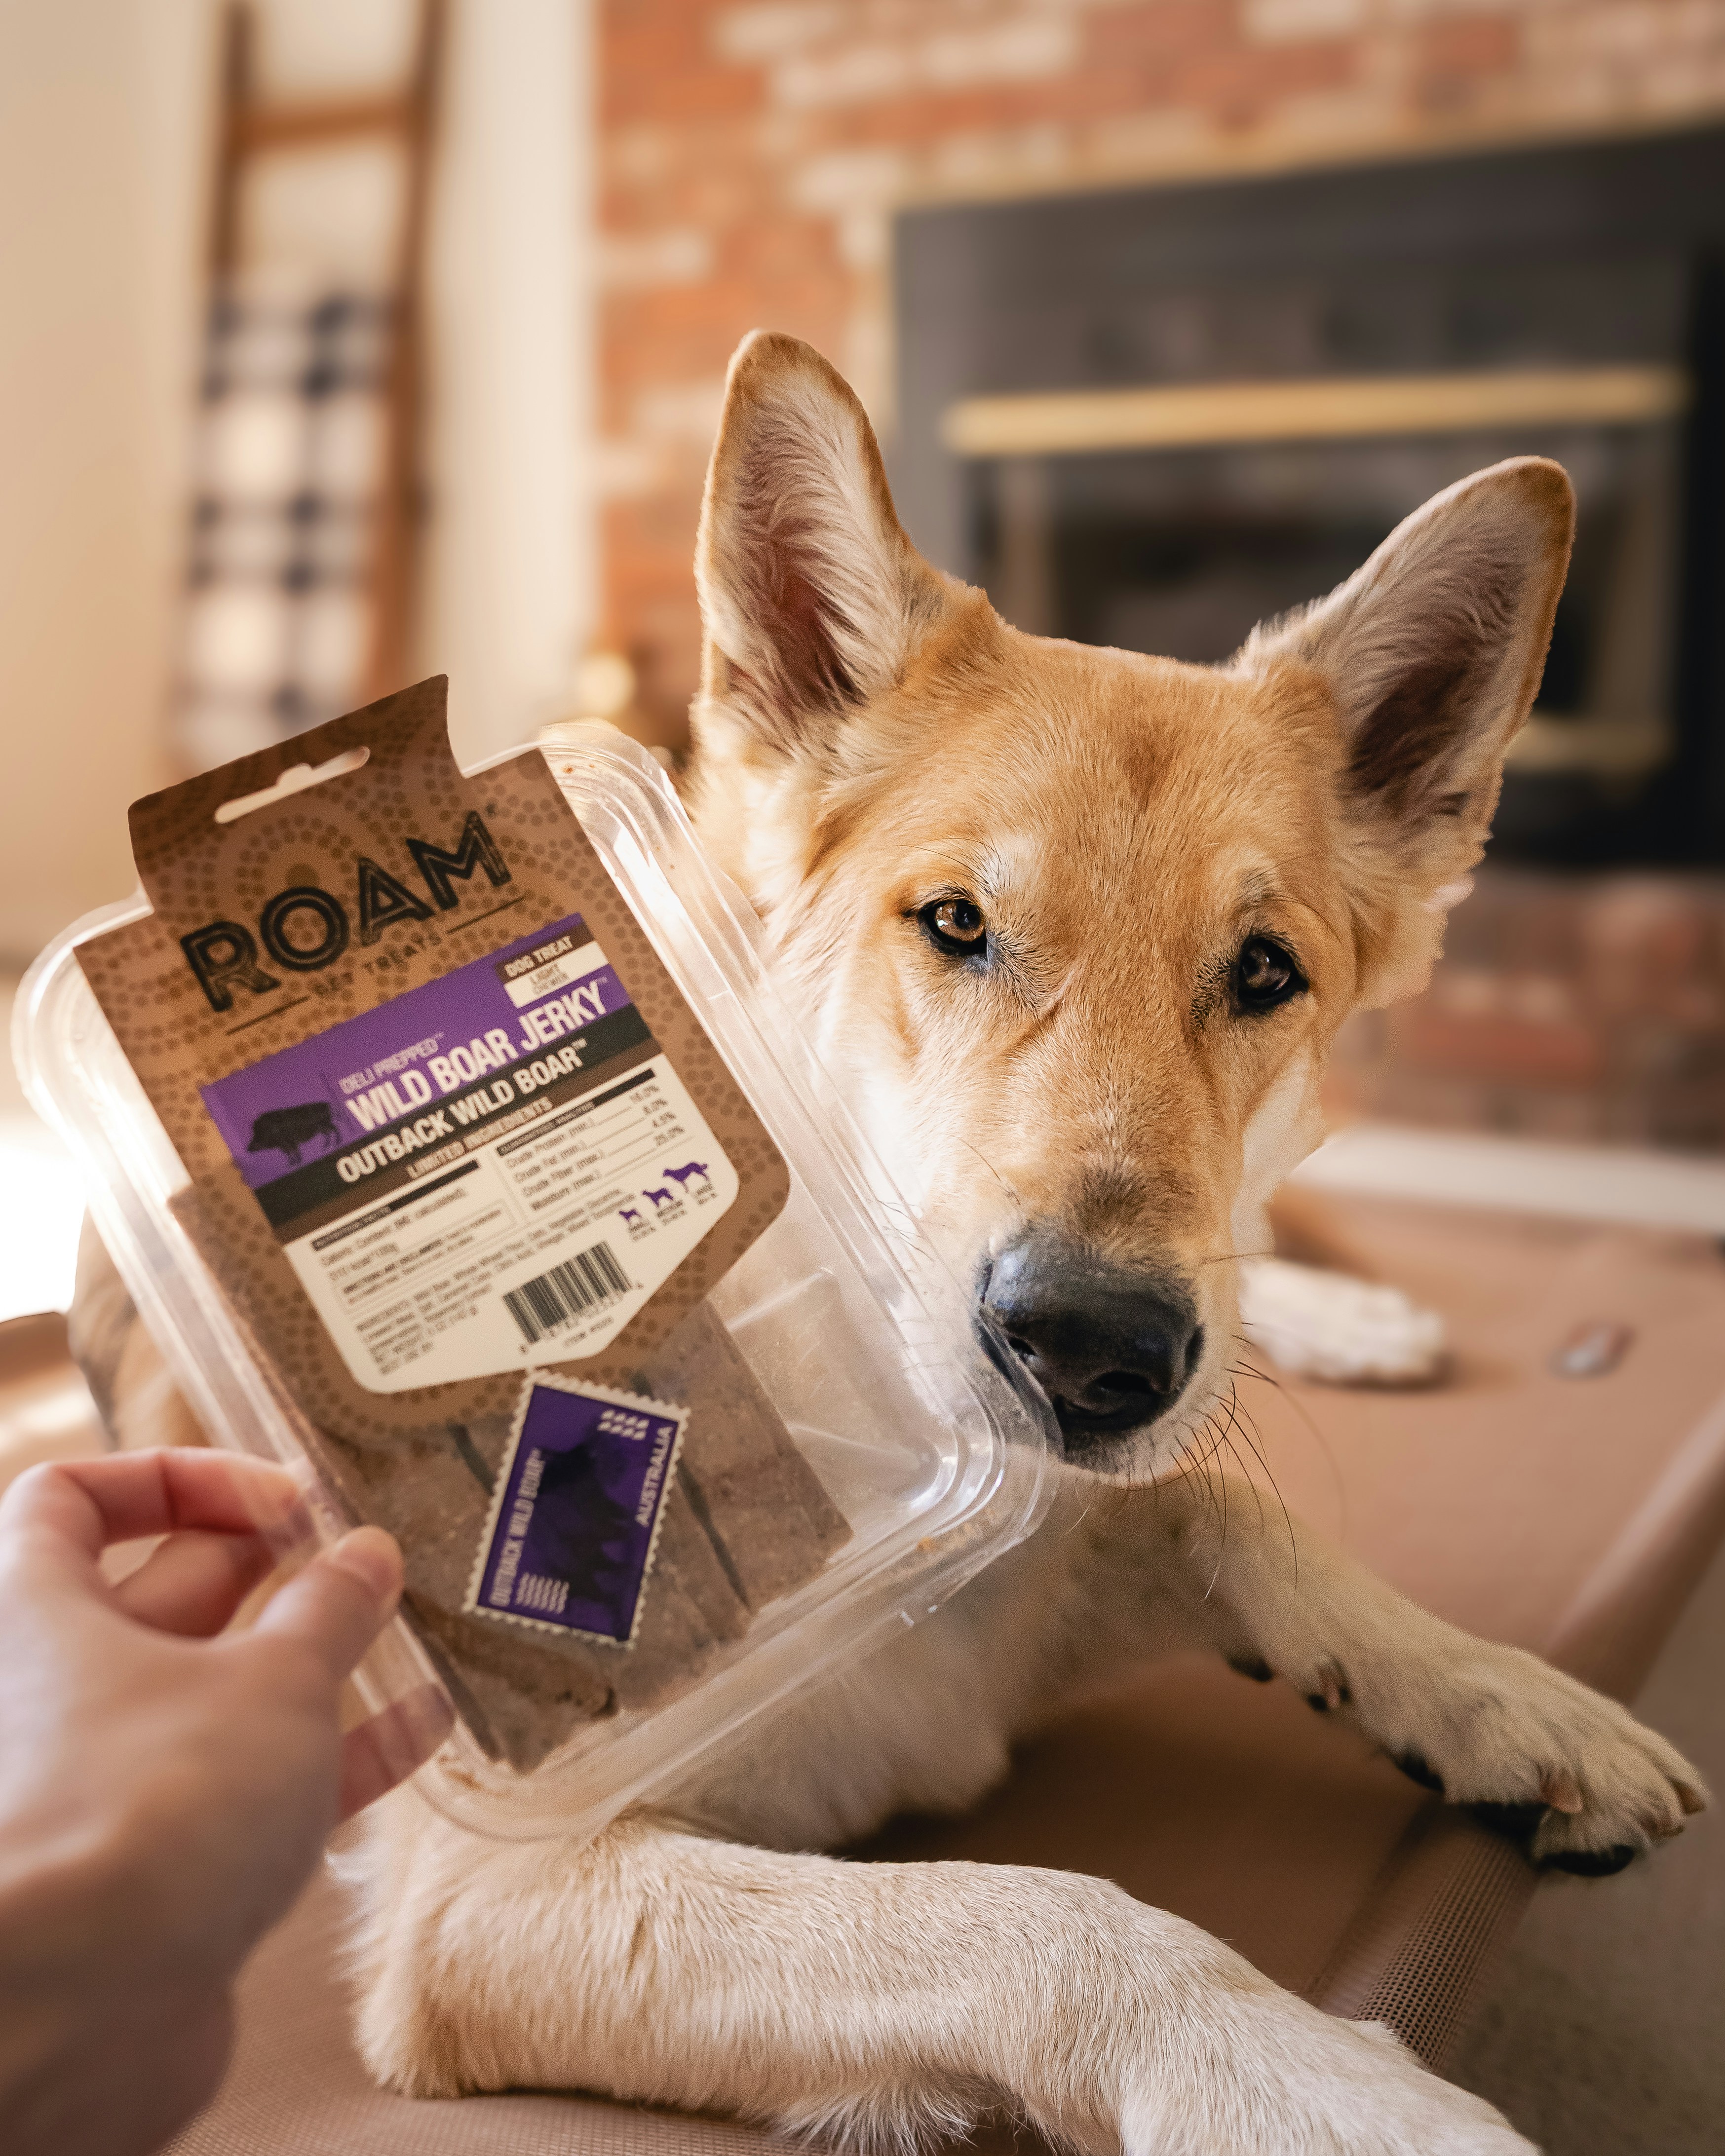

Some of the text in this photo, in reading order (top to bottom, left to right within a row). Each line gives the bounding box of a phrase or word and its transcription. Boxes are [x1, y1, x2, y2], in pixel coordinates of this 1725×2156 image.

[180, 811, 511, 1013] ROAM
[504, 935, 575, 978] DOG TREAT
[340, 1070, 374, 1095] DELI
[345, 1070, 432, 1131] WILD
[428, 1028, 514, 1092] BOAR
[337, 1110, 454, 1182] OUTBACK
[450, 1079, 515, 1126] WILD
[407, 1096, 553, 1178] LIMITED INGREDIENTS
[636, 1427, 673, 1527] AUSTRALIA
